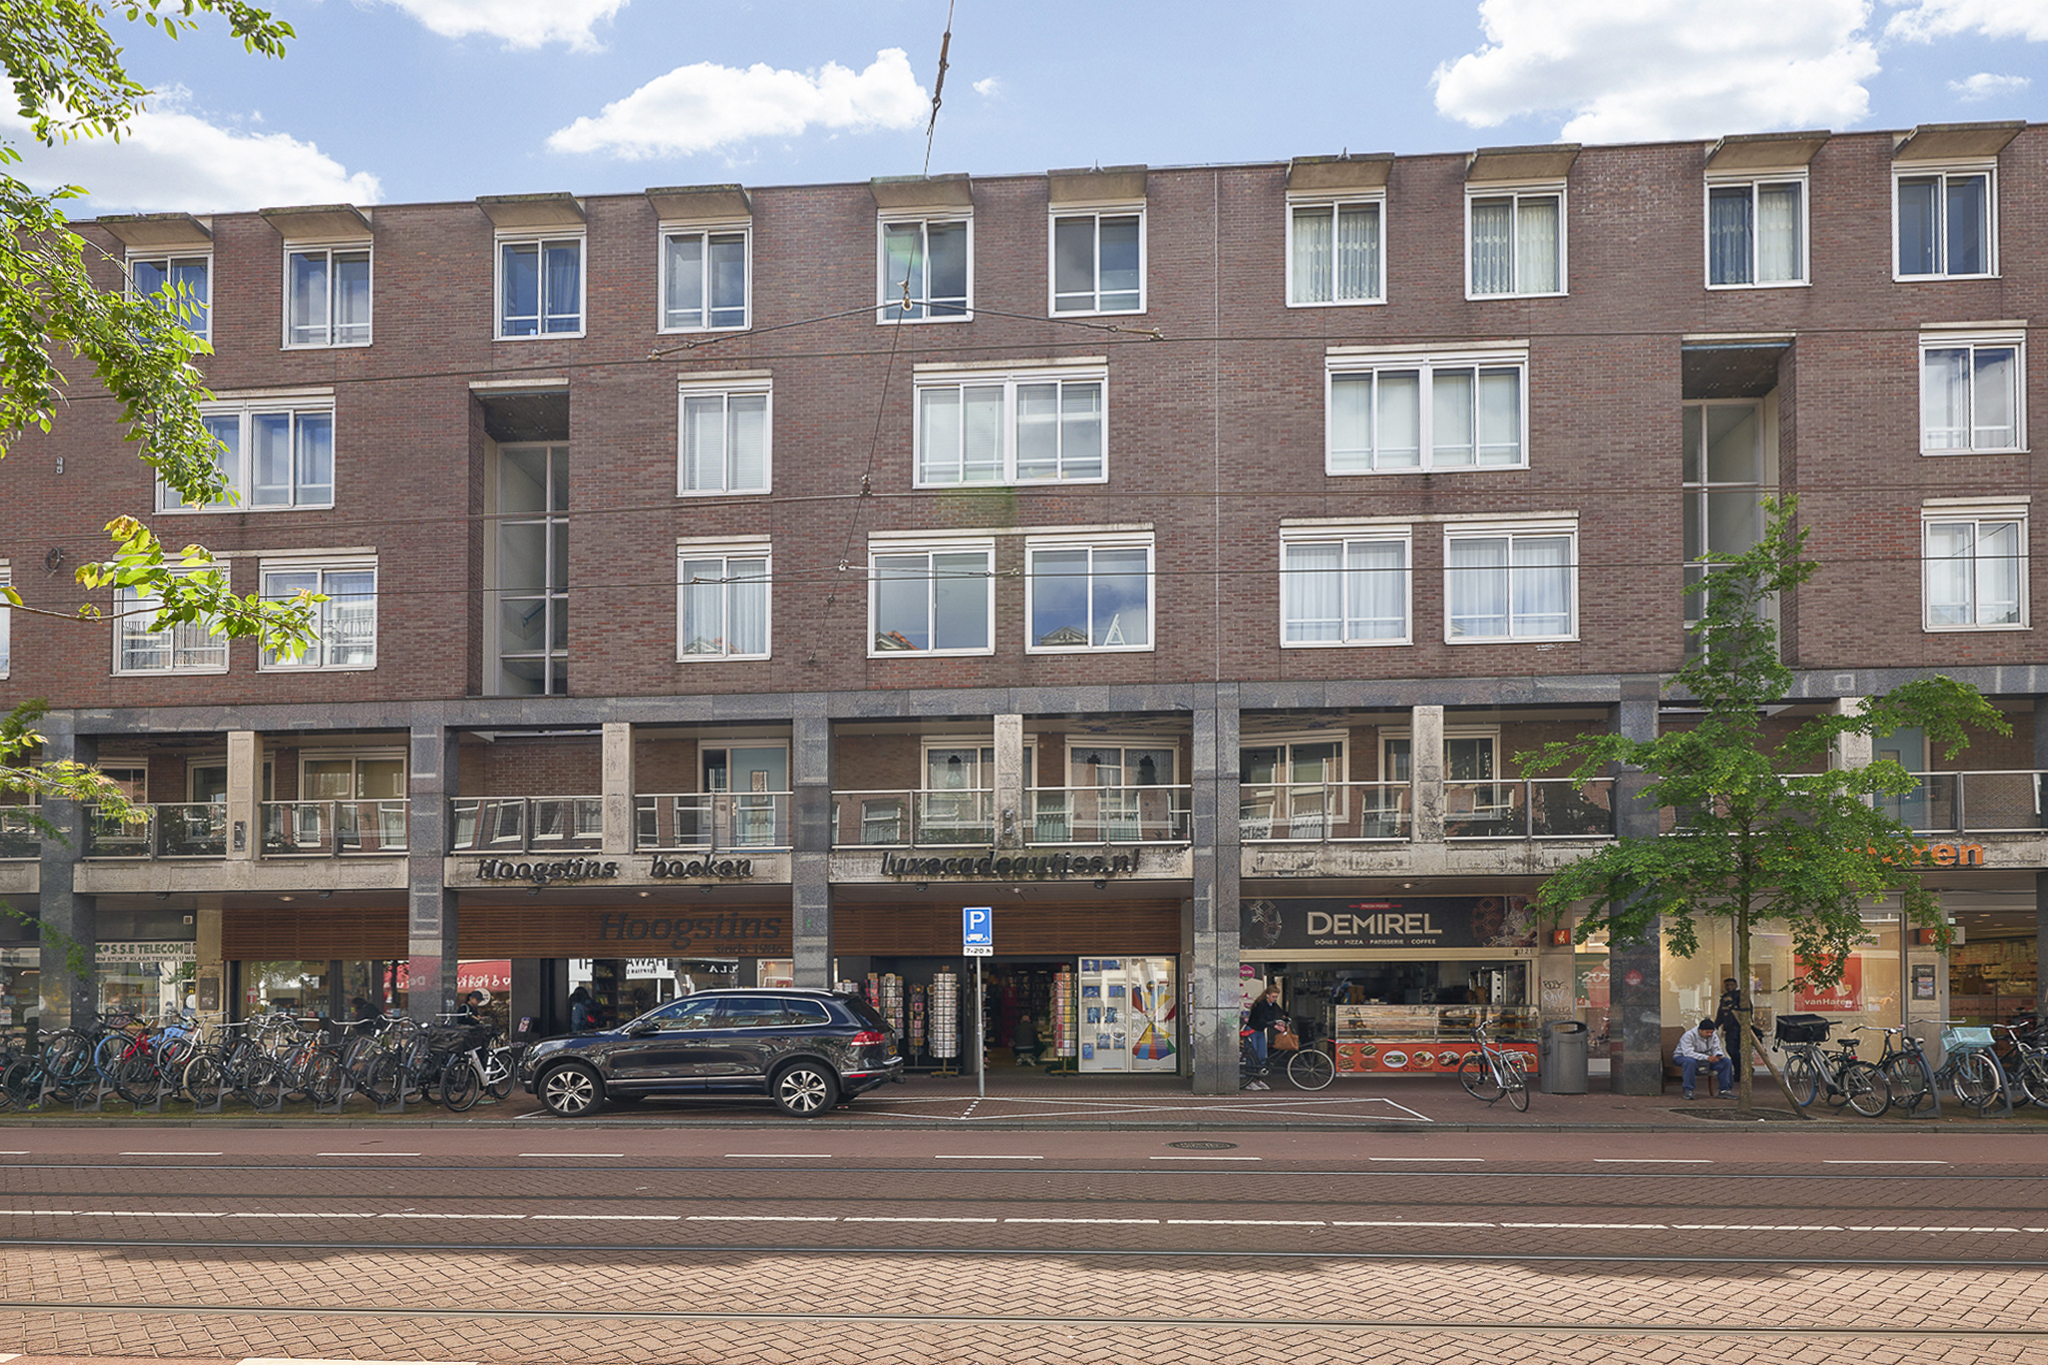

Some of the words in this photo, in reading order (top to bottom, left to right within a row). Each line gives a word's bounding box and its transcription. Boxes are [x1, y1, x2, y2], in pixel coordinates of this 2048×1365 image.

[475, 856, 621, 885] Hoogstins
[650, 853, 754, 879] boeken
[599, 912, 782, 950] Hoogstins
[970, 911, 985, 930] P
[1307, 911, 1443, 935] DEMIREL
[137, 943, 184, 955] TELECOM
[713, 943, 749, 955] sinds
[753, 943, 785, 954] 1986
